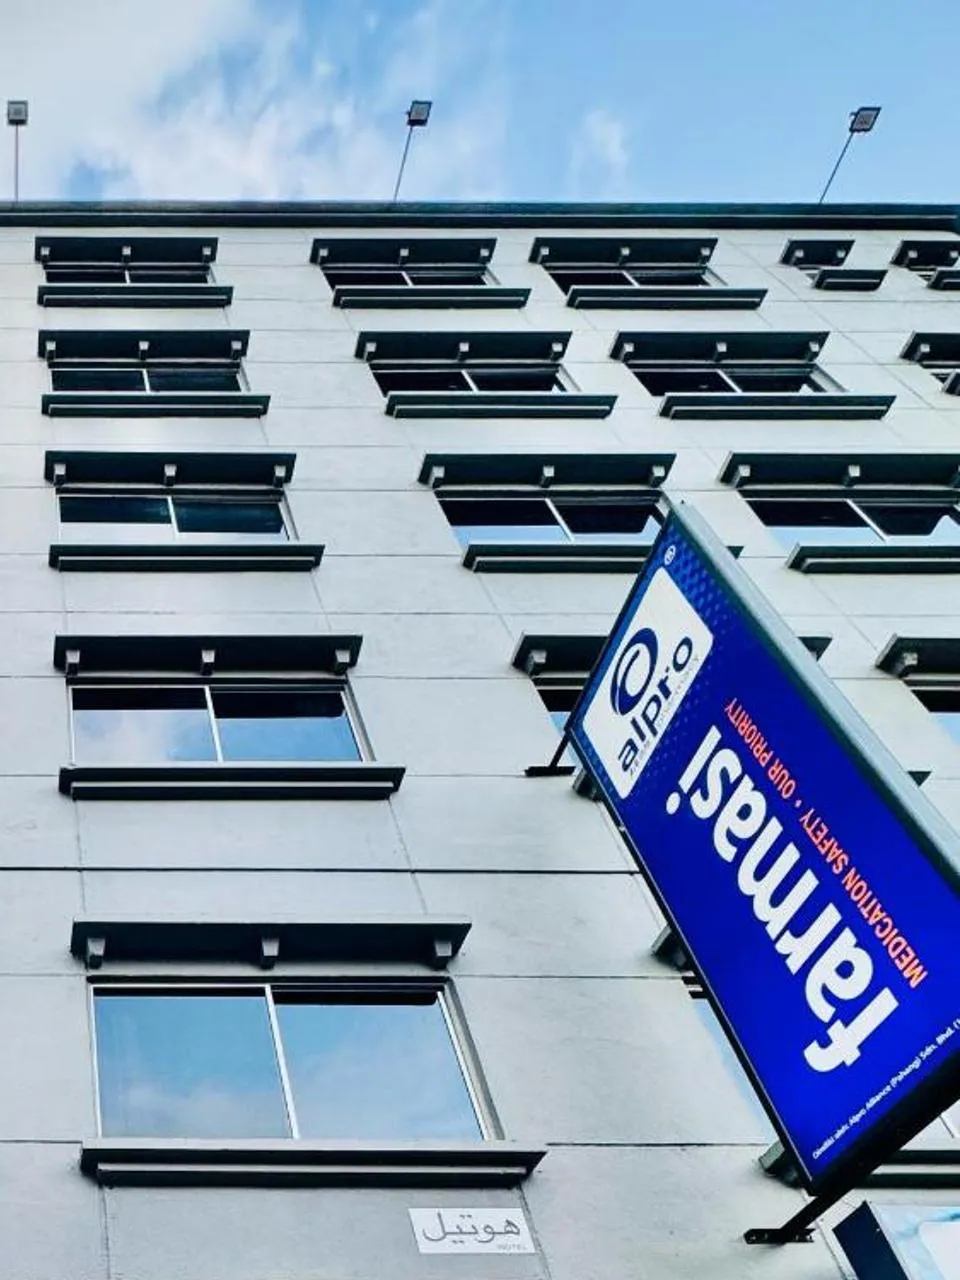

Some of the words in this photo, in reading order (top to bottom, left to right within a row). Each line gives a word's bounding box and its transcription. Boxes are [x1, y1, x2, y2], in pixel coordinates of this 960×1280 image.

[618, 636, 693, 772] alpro
[724, 697, 775, 768] PRIORITY
[768, 764, 797, 799] OUR
[799, 808, 849, 875] SAFETY
[665, 724, 899, 1073] farmasi
[841, 867, 928, 988] MEDICATION
